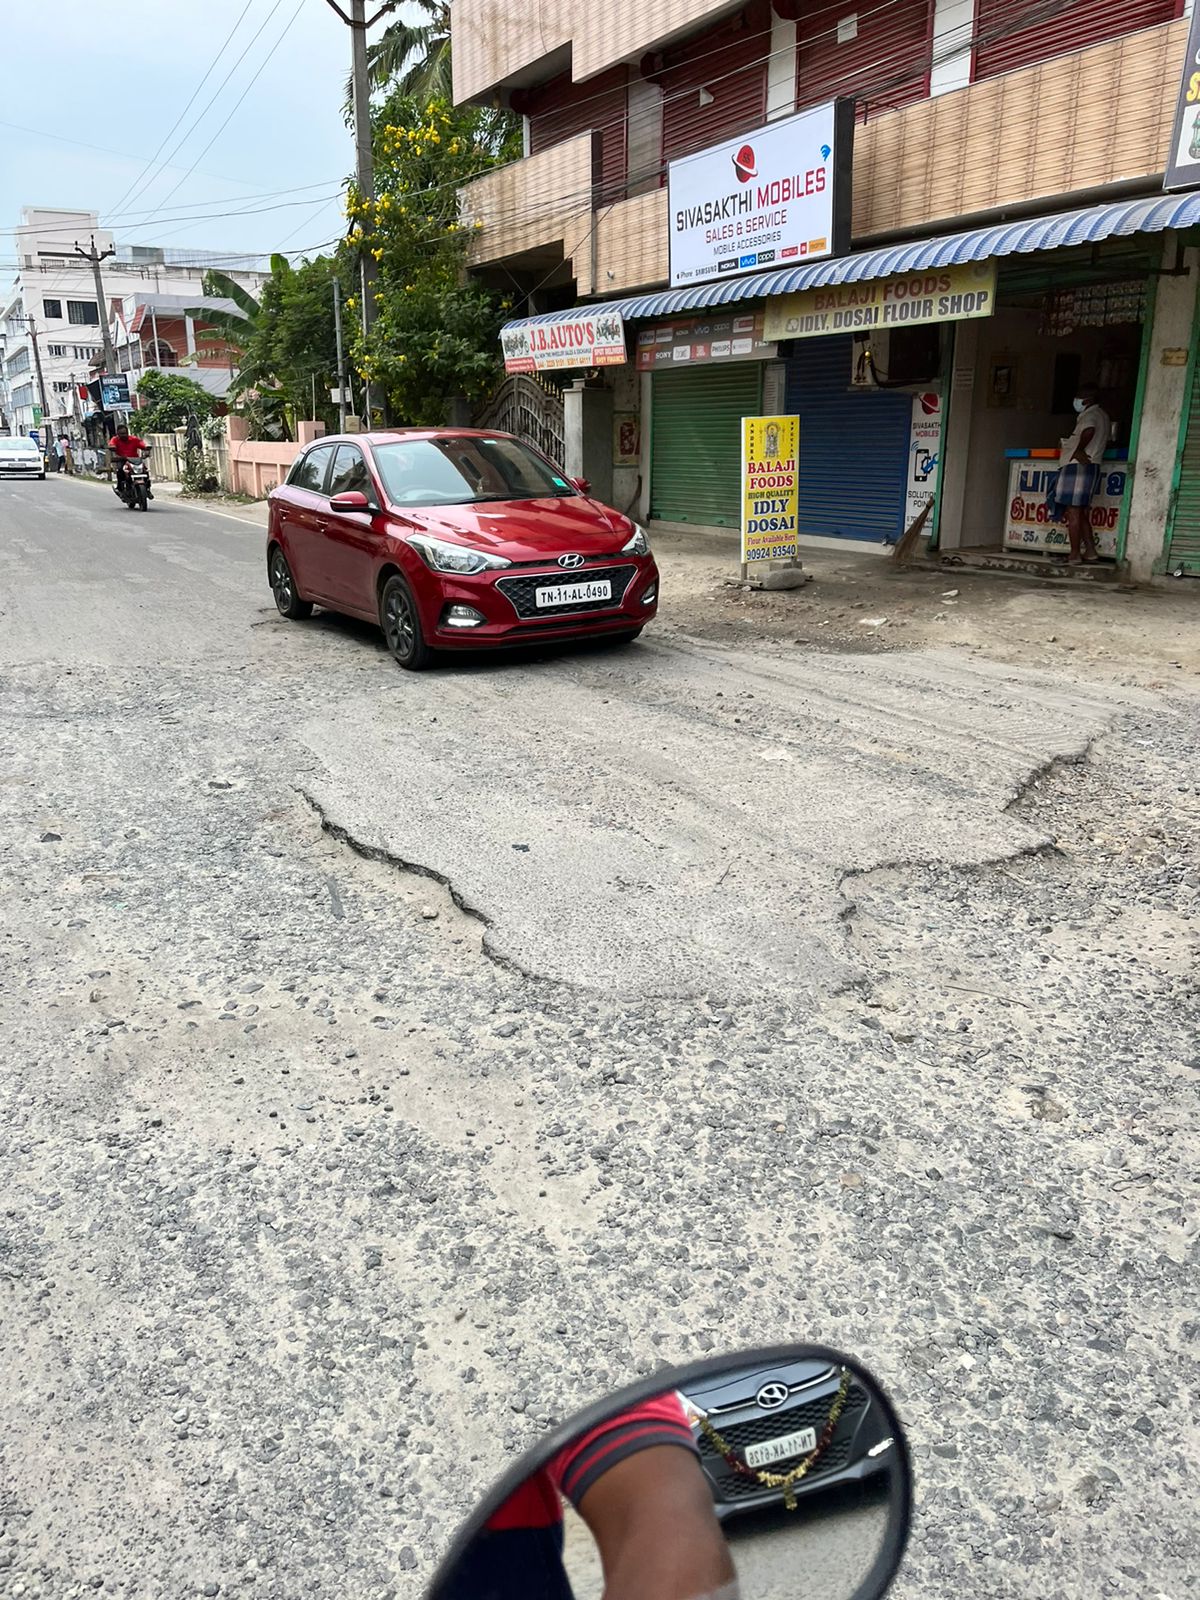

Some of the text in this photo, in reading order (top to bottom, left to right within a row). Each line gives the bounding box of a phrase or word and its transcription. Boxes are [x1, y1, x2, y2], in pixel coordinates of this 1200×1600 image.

[676, 167, 826, 232] SIVASAKTHI MOBILES
[705, 208, 788, 244] SALES & SERVICE
[713, 230, 782, 256] MOBILE ACCESSORIES
[814, 274, 951, 311] BALAJI FOODS
[800, 291, 988, 333] IDLY, DOSAI FLOUR SHOP
[530, 321, 595, 352] J.B.AUTO'S
[656, 350, 672, 360] SONY
[915, 430, 940, 438] MOBILES
[748, 460, 796, 474] BALAJI
[750, 475, 794, 490] FOODS
[748, 489, 794, 500] HIGH QUALITY
[754, 499, 790, 515] IDLY
[748, 516, 796, 534] DOSAI
[762, 534, 784, 544] Available
[747, 544, 796, 560] 90924 93540
[540, 584, 608, 603] TN-11-AL-0490
